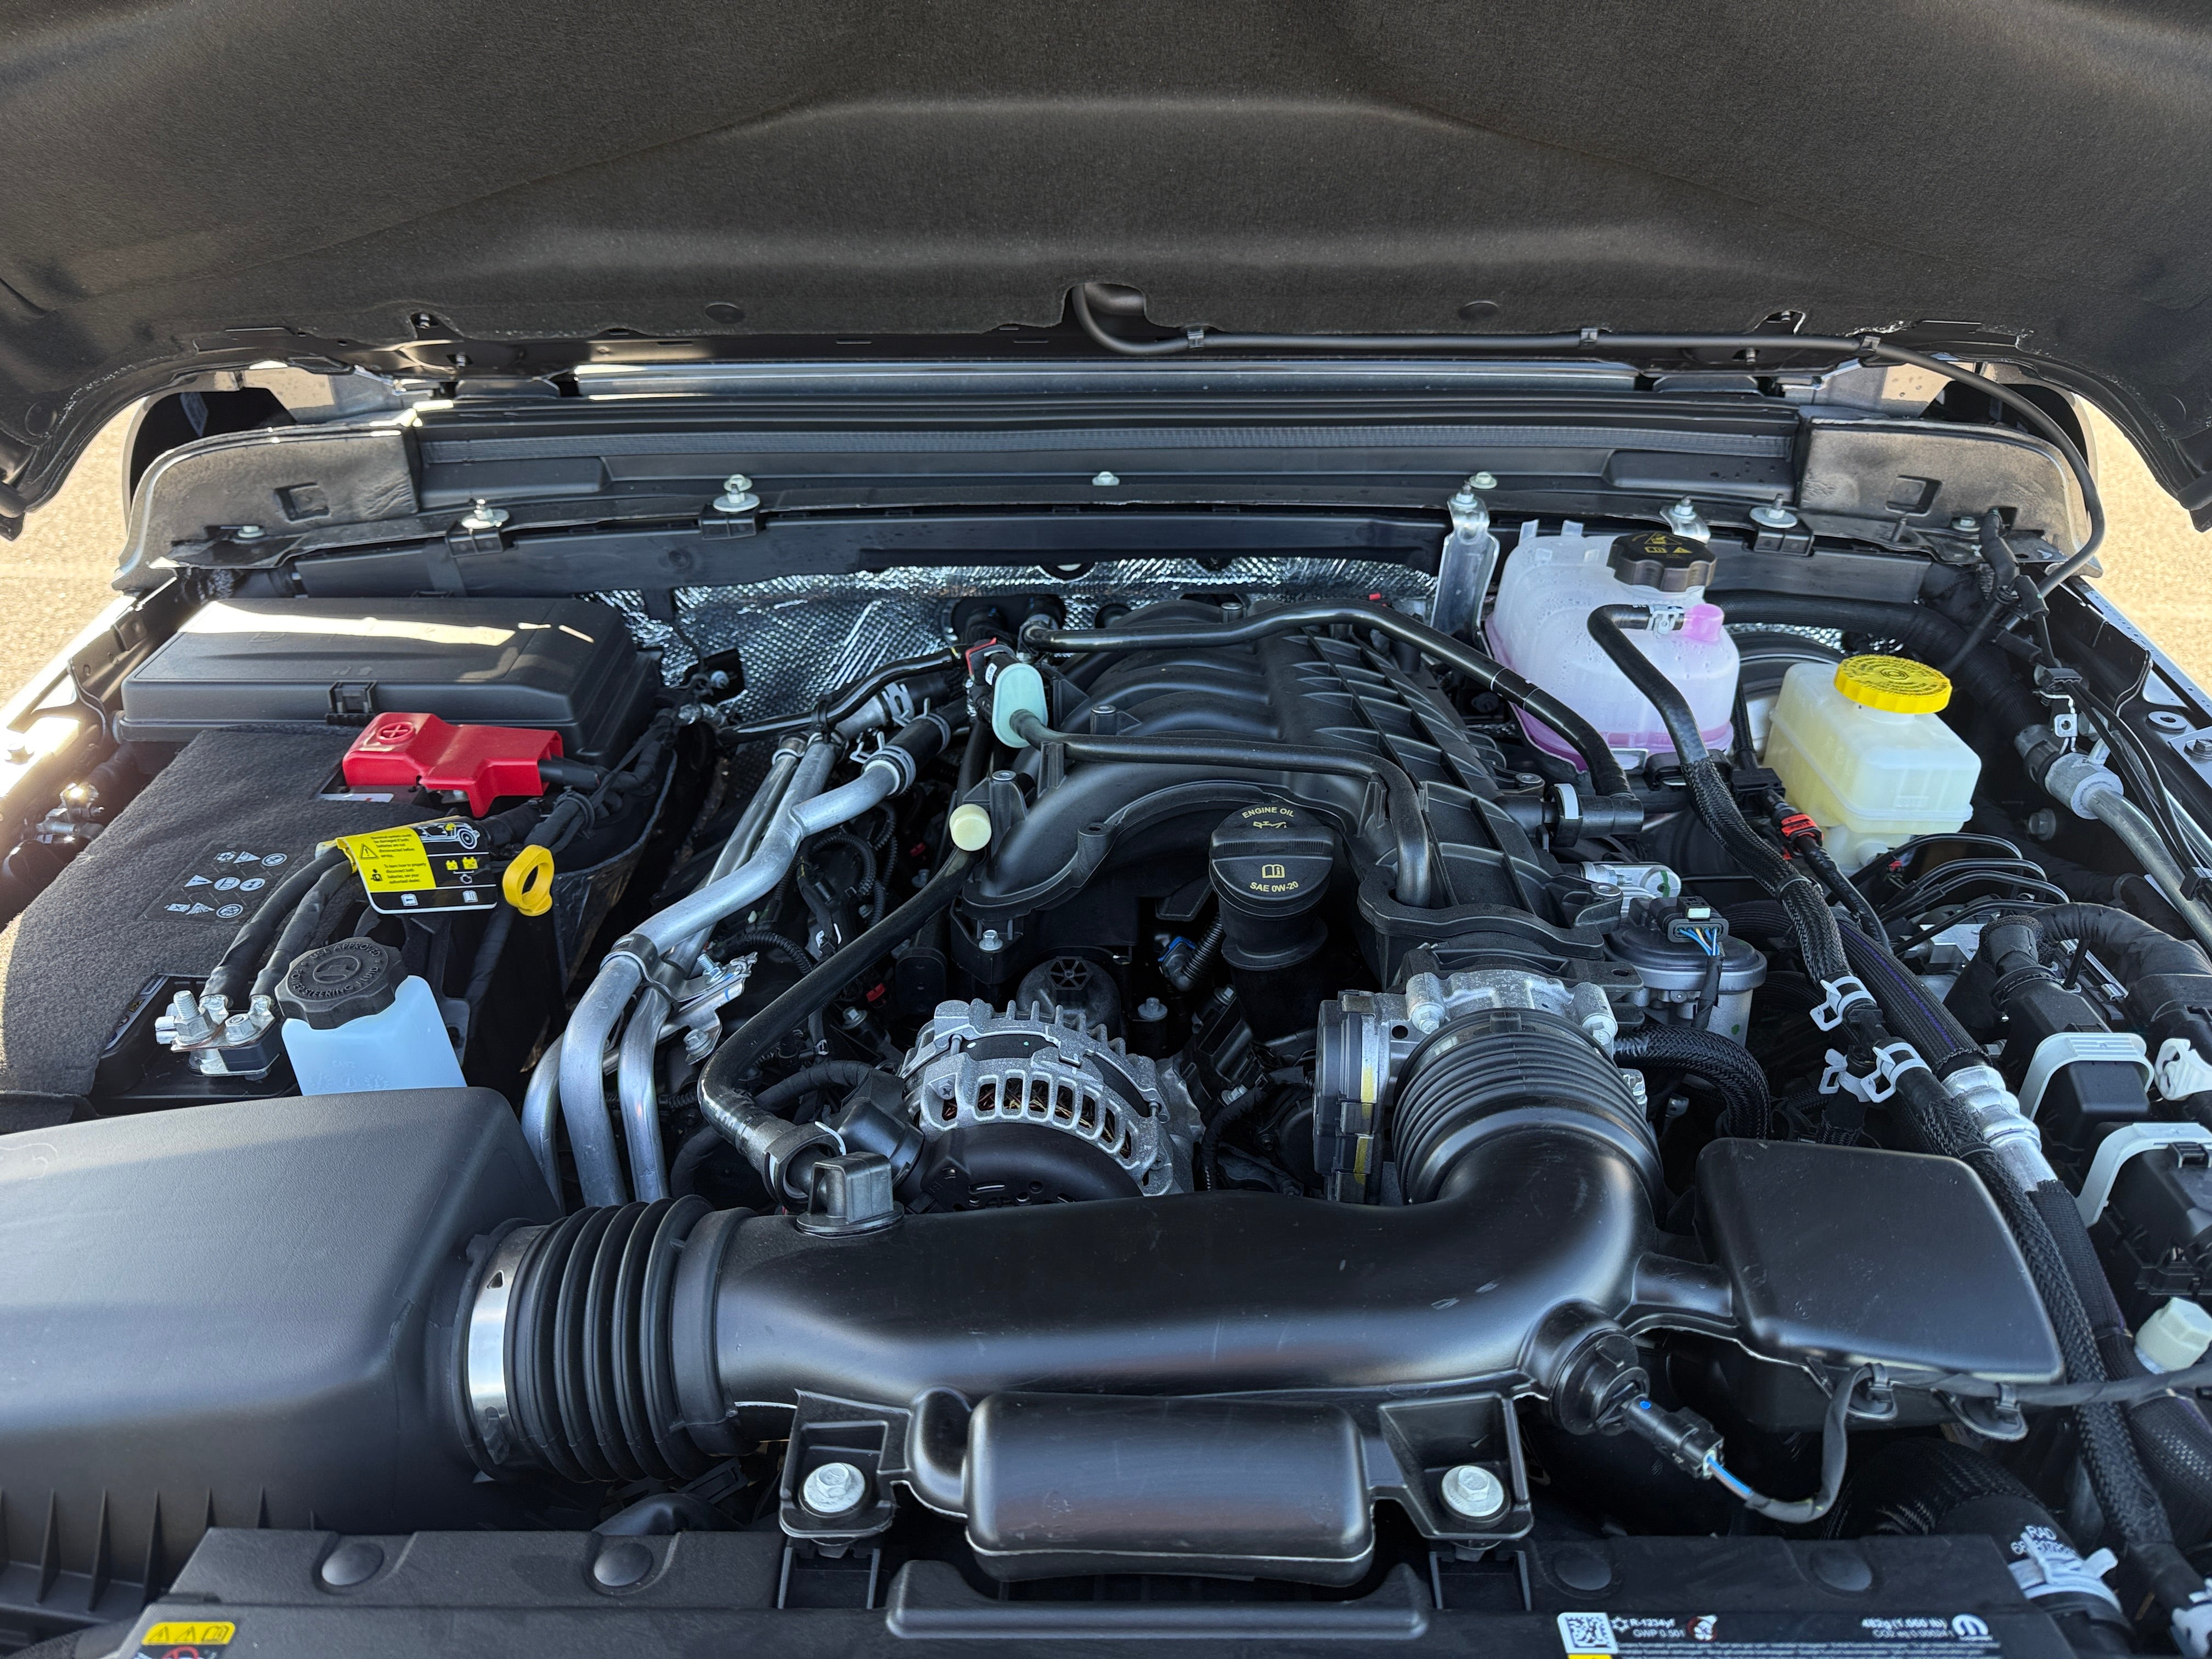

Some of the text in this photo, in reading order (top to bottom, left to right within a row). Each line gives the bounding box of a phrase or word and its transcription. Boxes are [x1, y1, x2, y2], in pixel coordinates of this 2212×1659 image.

[1242, 806, 1294, 819] ENGINE OIL
[1249, 881, 1299, 892] SAE 0W-20
[333, 942, 381, 957] APPROVED
[302, 985, 353, 997] STEERING
[2025, 1525, 2057, 1541] RAD
